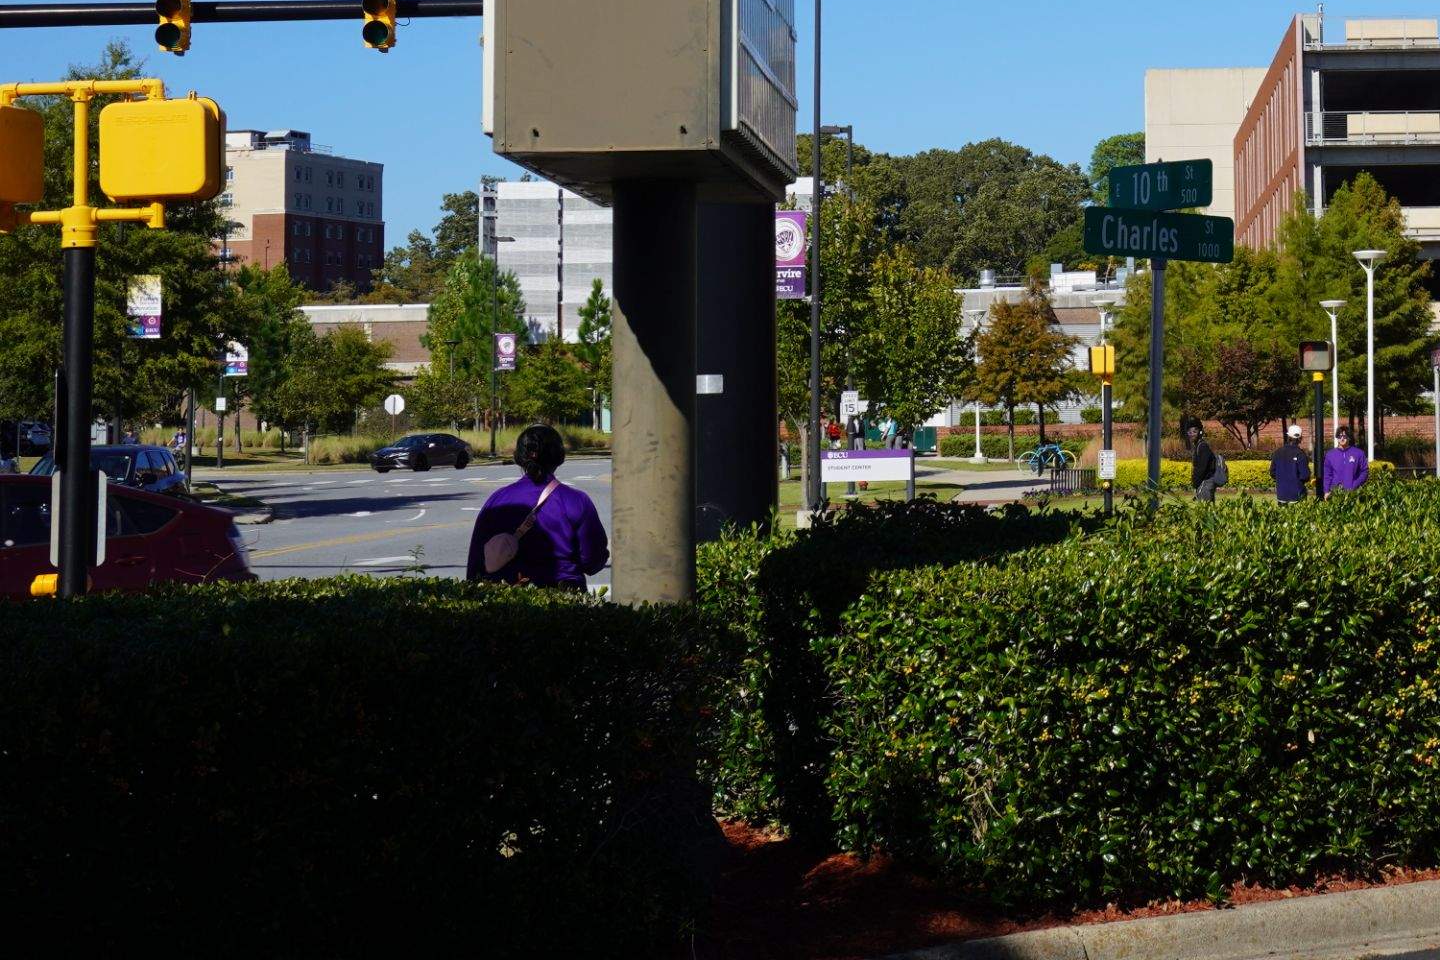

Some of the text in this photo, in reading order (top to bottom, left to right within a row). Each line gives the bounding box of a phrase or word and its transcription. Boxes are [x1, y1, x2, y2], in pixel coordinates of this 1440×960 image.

[1184, 165, 1195, 180] St
[1180, 188, 1197, 204] 500
[1102, 214, 1214, 253] Charles St
[1198, 243, 1220, 258] 1000
[844, 403, 856, 413] 15
